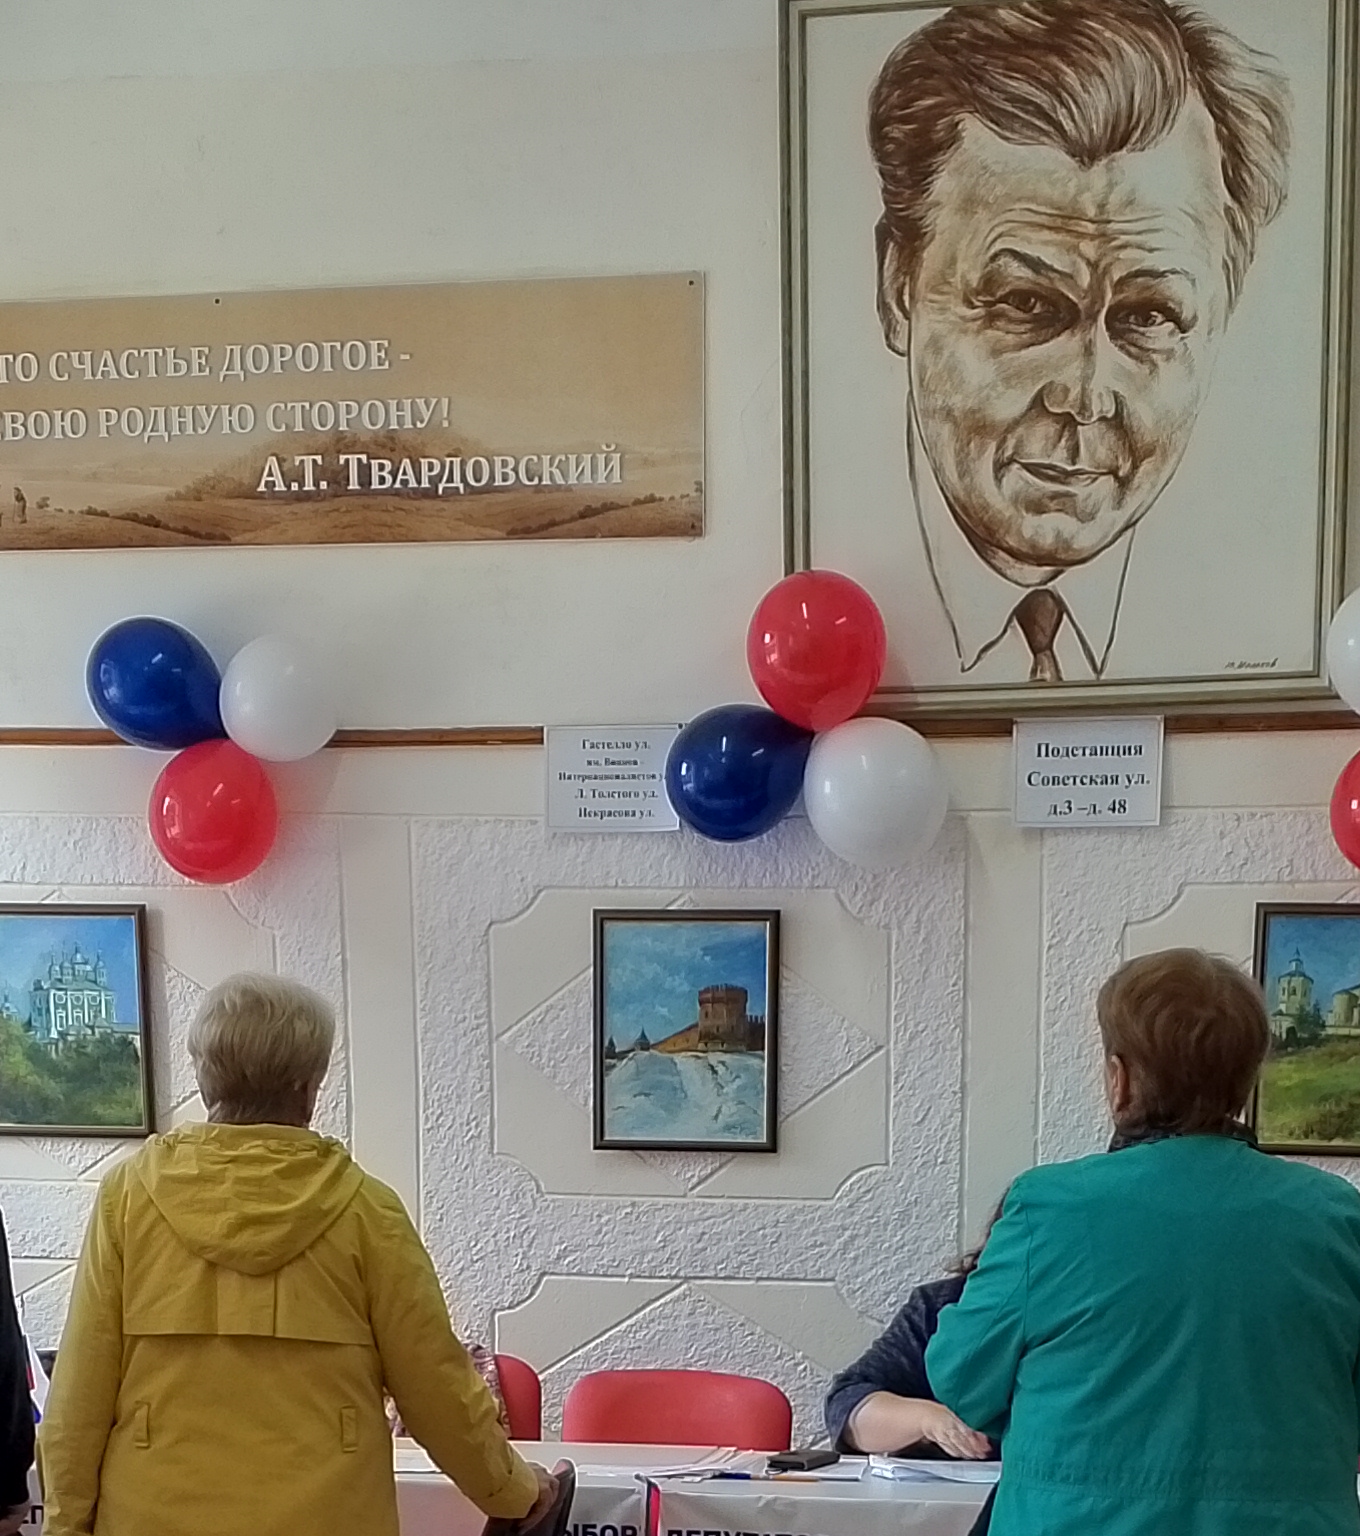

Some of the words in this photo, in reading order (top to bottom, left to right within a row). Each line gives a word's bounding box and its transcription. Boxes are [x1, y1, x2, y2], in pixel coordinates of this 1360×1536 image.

[48, 346, 210, 381] СЧАСТЬЕ
[219, 339, 389, 382] ДОРОГОЕ
[97, 403, 255, 444] РОДНУЮ
[265, 397, 450, 434] СТОРОНУ!
[256, 454, 328, 492] А.Т.
[338, 443, 623, 495] ТВАРДОВСКИЙ
[581, 739, 632, 750] Гастелло
[634, 740, 651, 752] ул.
[1036, 742, 1143, 759] Подстанция
[1026, 771, 1120, 787] Советская
[1124, 773, 1151, 789] ул.
[590, 788, 640, 800] Толстого
[641, 789, 659, 802] ул.
[578, 806, 637, 820] Некрасова
[639, 808, 655, 820] ул.
